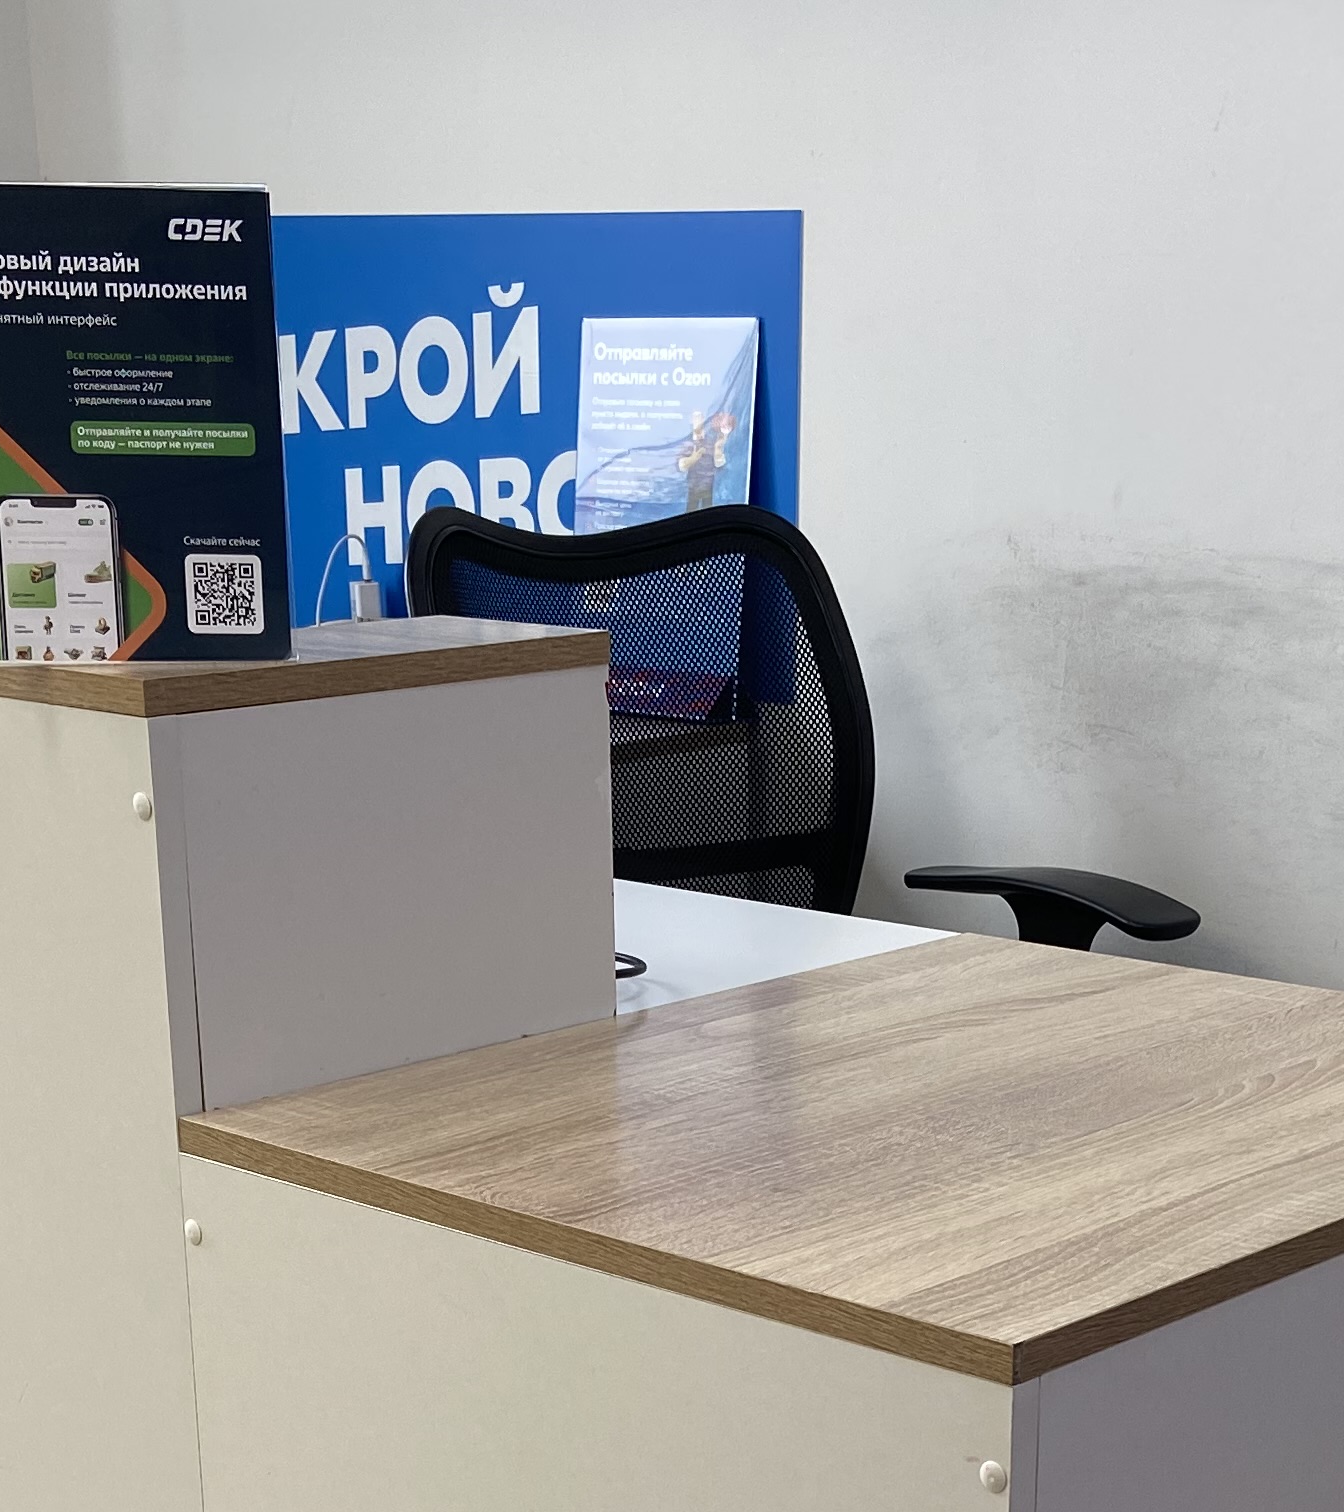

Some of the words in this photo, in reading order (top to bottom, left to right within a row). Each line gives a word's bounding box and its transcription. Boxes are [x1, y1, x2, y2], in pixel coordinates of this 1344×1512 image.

[168, 218, 244, 242] CDEK
[58, 252, 140, 275] дизайн
[105, 281, 248, 302] приложения
[47, 312, 117, 328] интерфейс
[66, 350, 85, 361] Все
[87, 352, 132, 362] посылки
[145, 353, 157, 362] на
[159, 354, 192, 364] одном
[594, 342, 693, 366] Отправляйте
[72, 367, 112, 379] быстрое
[114, 368, 174, 380] оформление
[593, 371, 657, 385] посылки
[660, 372, 669, 386] с
[672, 367, 711, 386] Ozon
[74, 382, 141, 392] отслеживание
[142, 382, 164, 394] 24/7
[74, 396, 137, 407] уведомления
[147, 398, 184, 408] каждом
[77, 426, 142, 438] Отправляйте
[152, 428, 203, 439] получайте
[205, 429, 248, 439] посылки
[78, 440, 90, 448] по
[92, 440, 116, 450] коду
[127, 440, 167, 450] паспорт
[169, 441, 181, 449] не
[183, 441, 214, 451] нужен
[183, 535, 227, 546] Скачайте
[228, 536, 261, 547] сейчас
